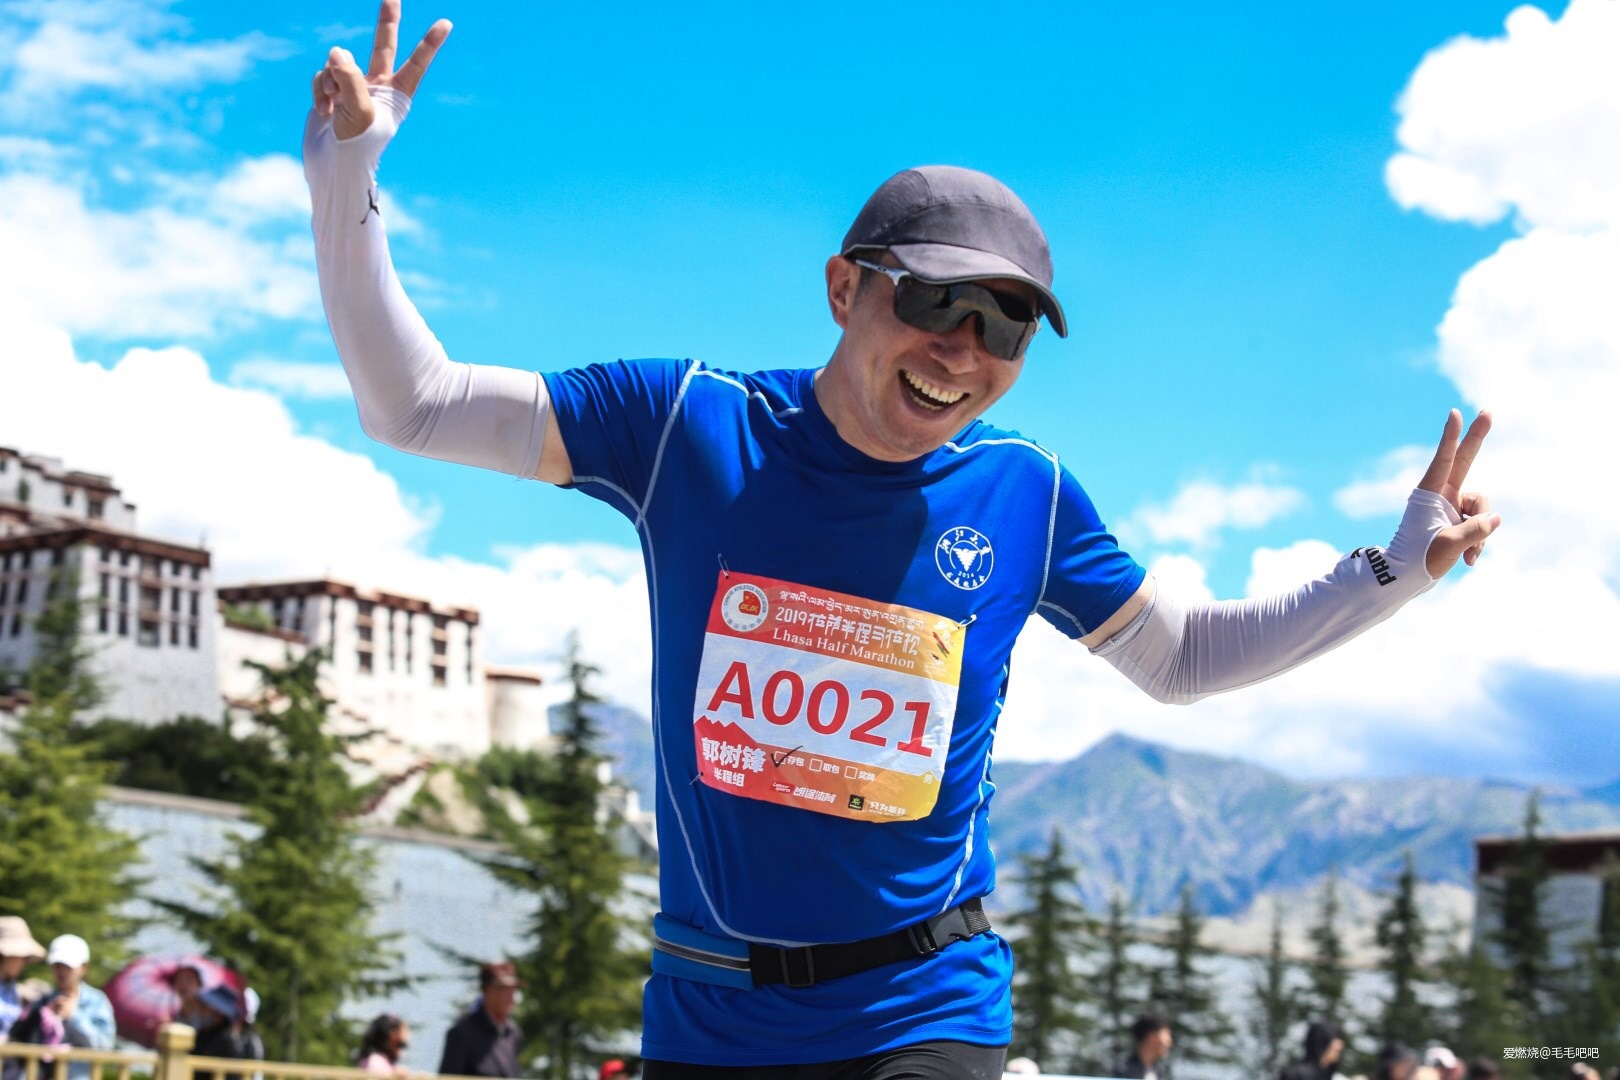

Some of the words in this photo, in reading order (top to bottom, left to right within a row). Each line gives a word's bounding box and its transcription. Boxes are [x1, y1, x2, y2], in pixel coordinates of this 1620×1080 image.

[773, 628, 813, 647] Lhasa
[817, 637, 849, 654] Half
[850, 644, 915, 669] Marathon
[706, 660, 933, 757] A0021
[701, 737, 766, 773] 郭树锋
[713, 767, 745, 787] 半程组
